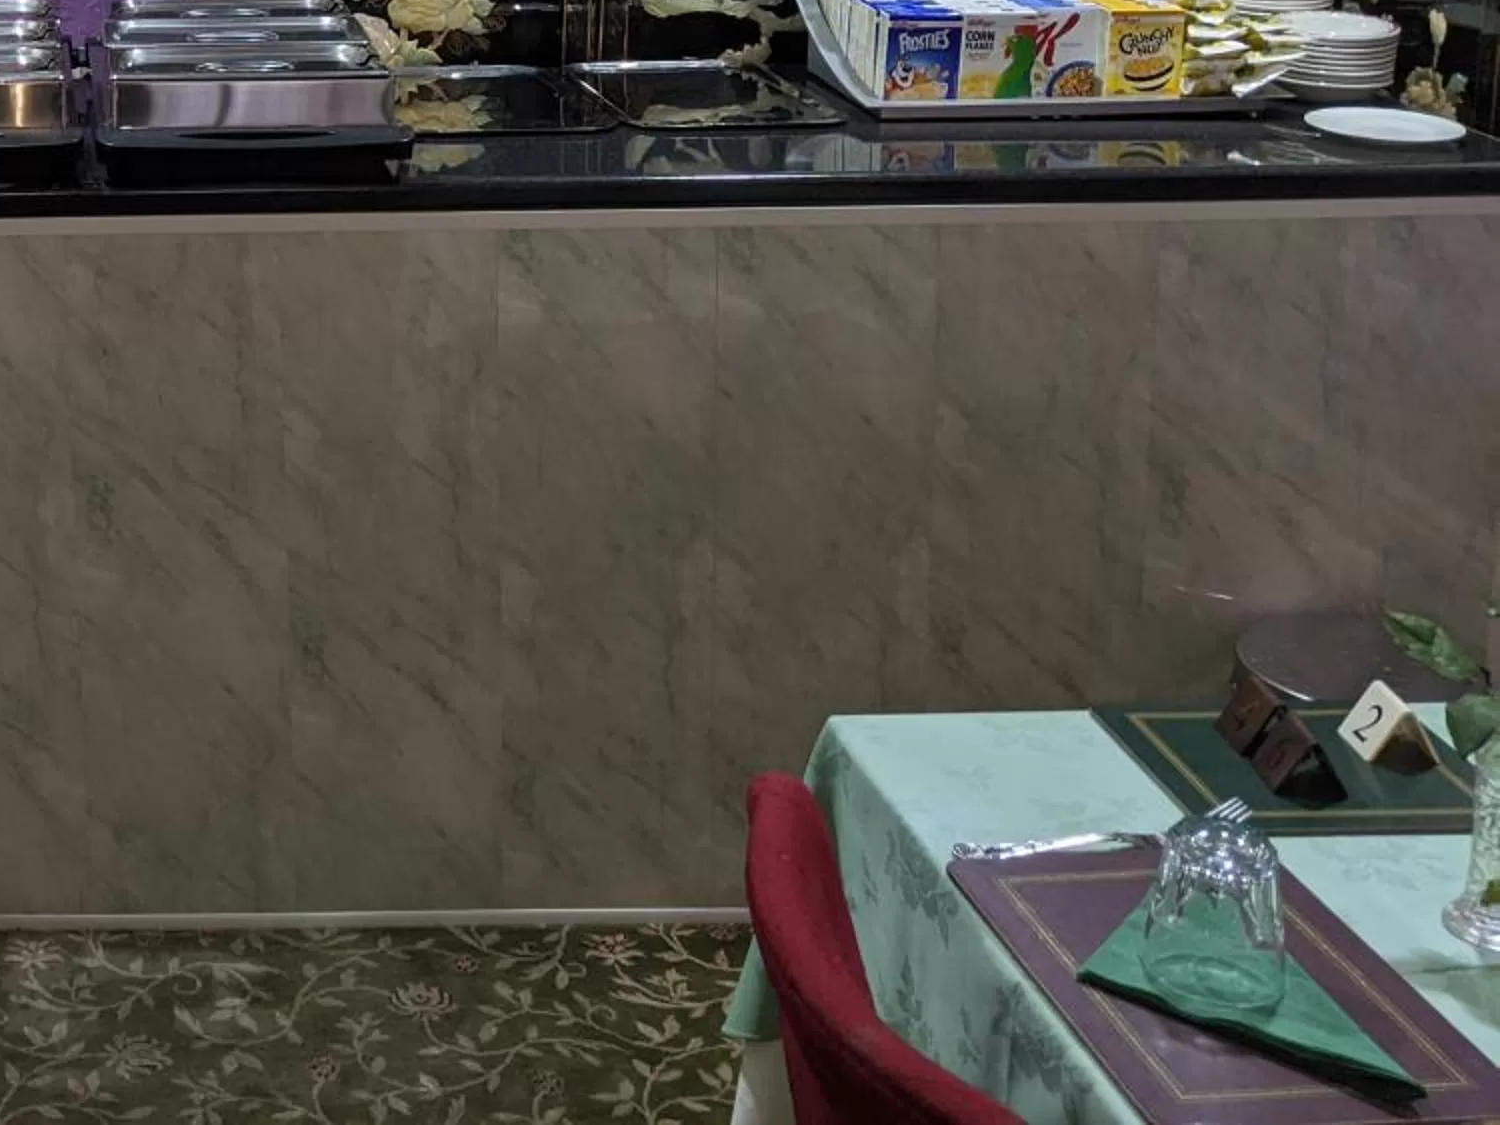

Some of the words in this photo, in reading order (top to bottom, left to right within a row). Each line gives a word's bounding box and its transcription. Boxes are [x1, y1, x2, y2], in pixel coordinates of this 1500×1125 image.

[898, 28, 951, 54] FROSTIES
[965, 30, 996, 43] CORN
[1351, 704, 1384, 744] 2
